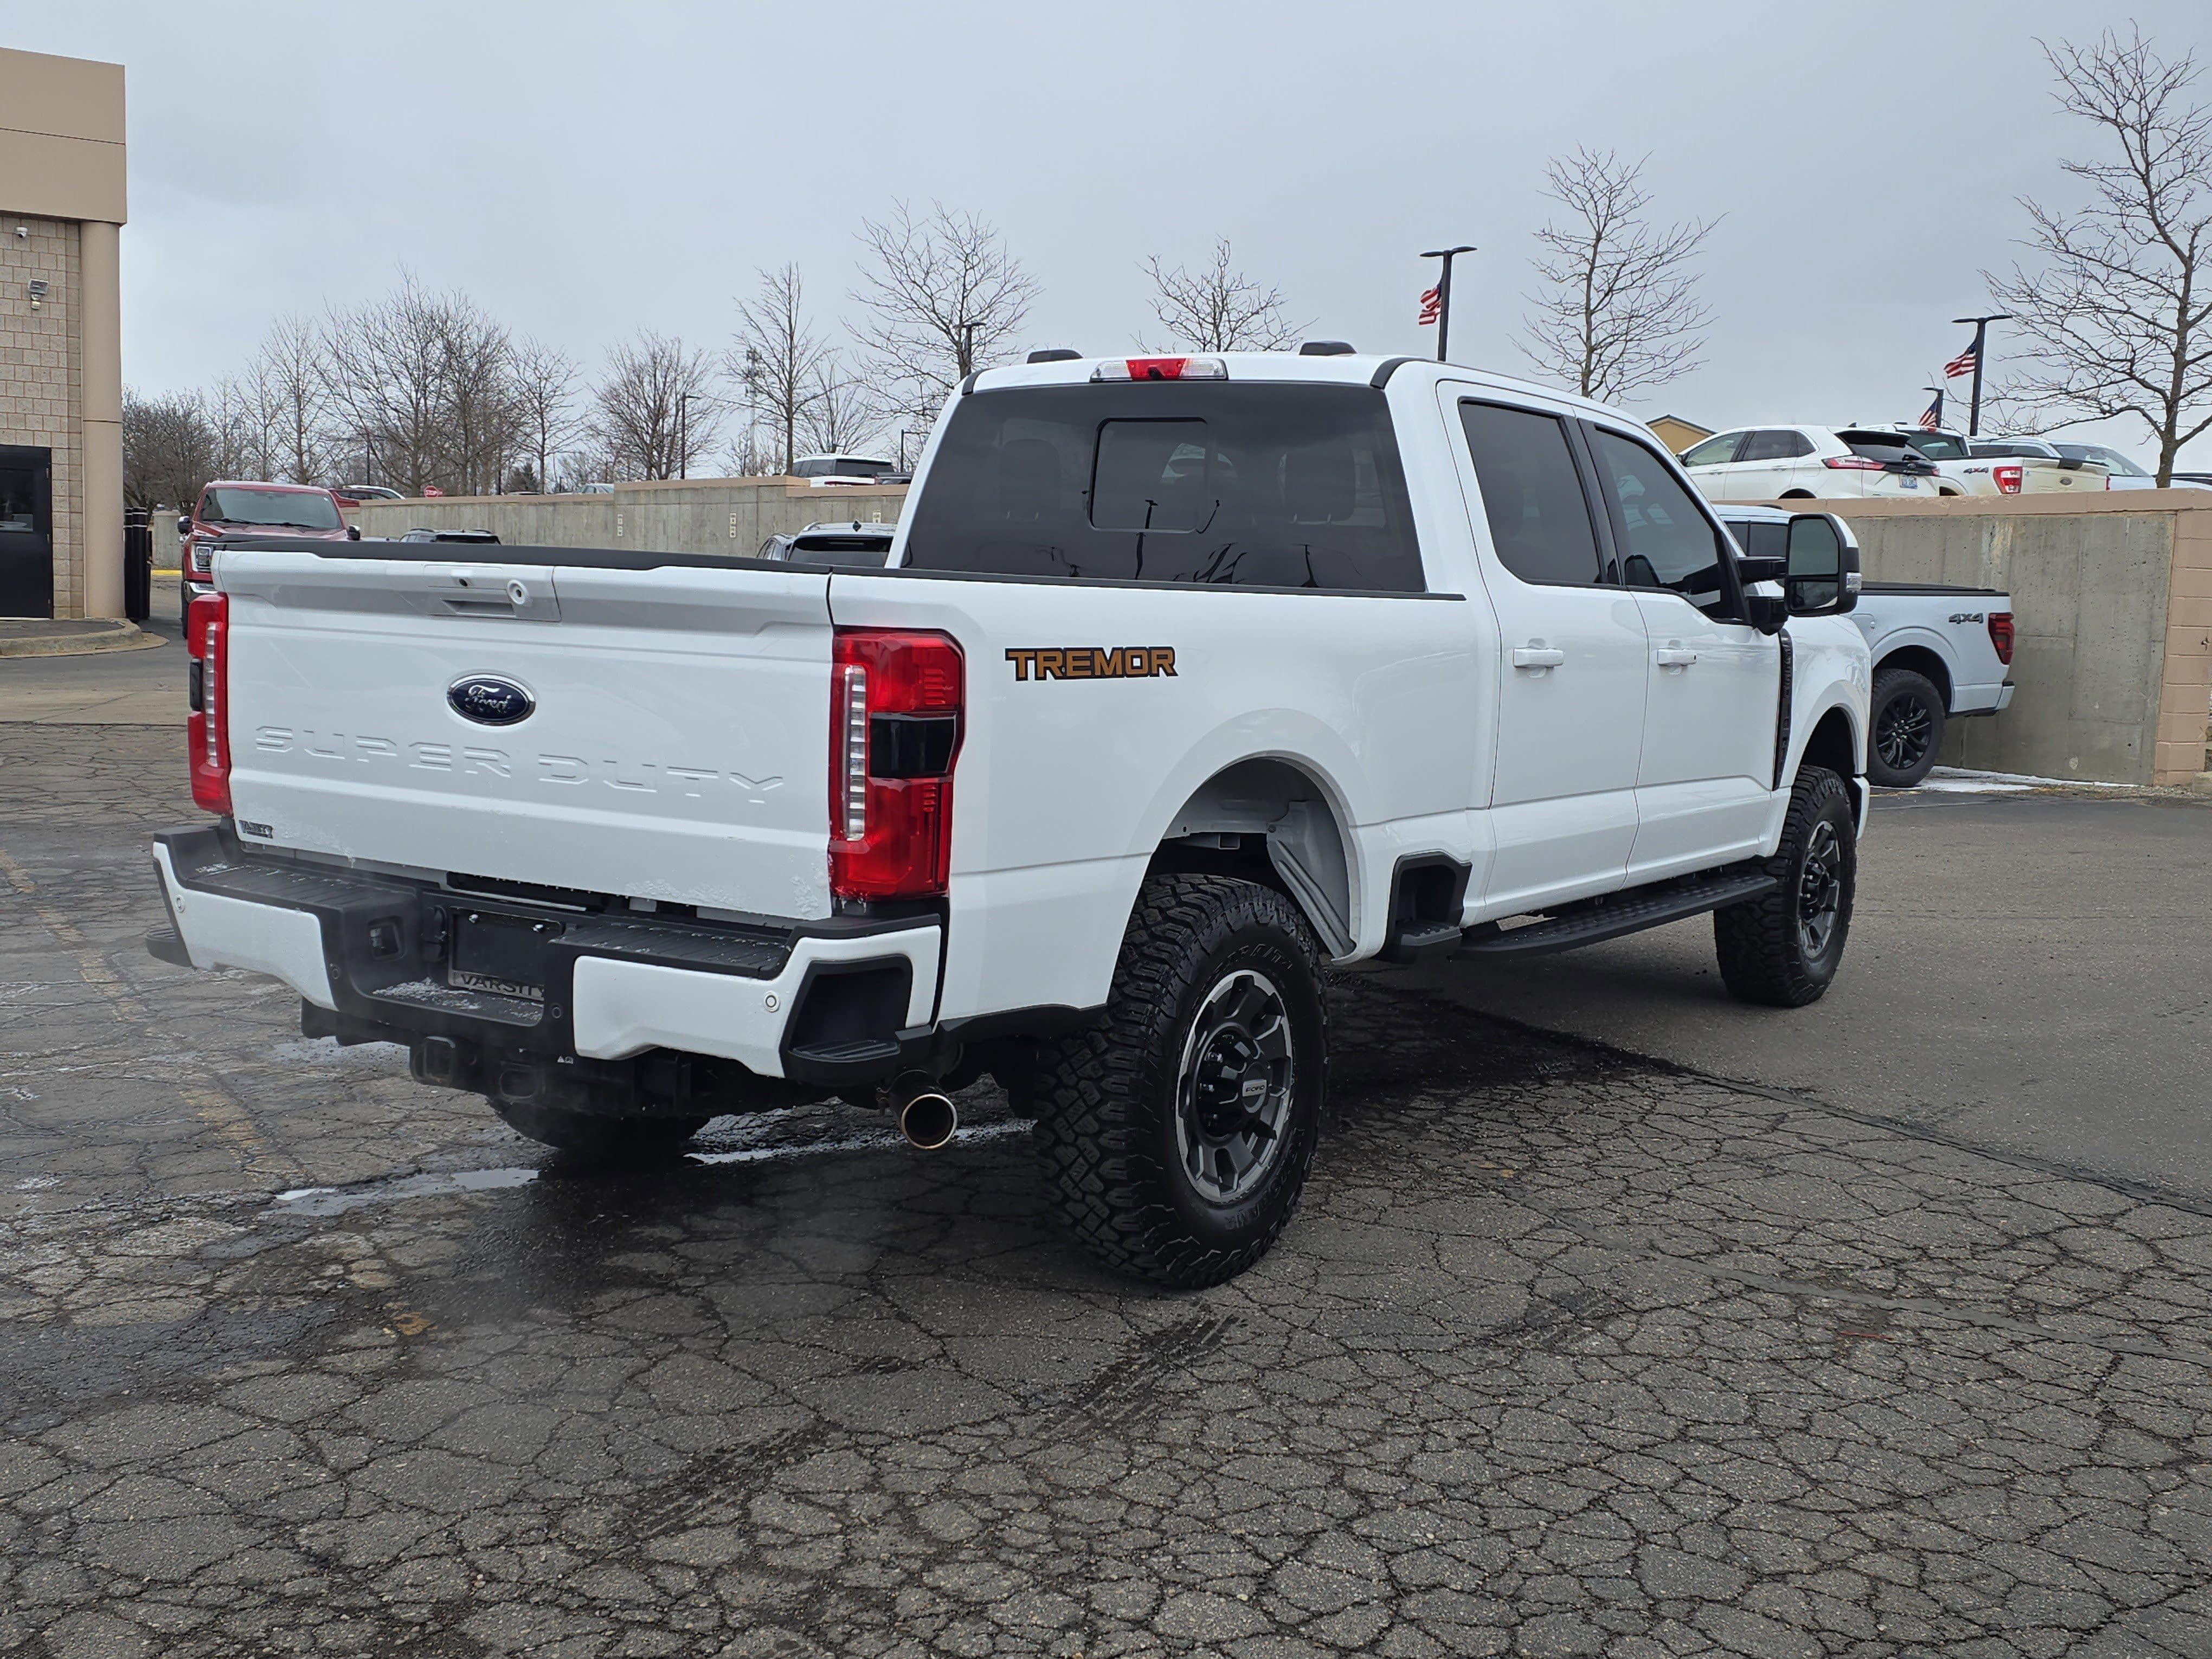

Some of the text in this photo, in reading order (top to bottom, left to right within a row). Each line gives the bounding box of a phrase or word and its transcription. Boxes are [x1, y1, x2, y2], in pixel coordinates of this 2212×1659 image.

[1005, 647, 1179, 681] TREMOR
[256, 725, 784, 803] SUPER DUTY
